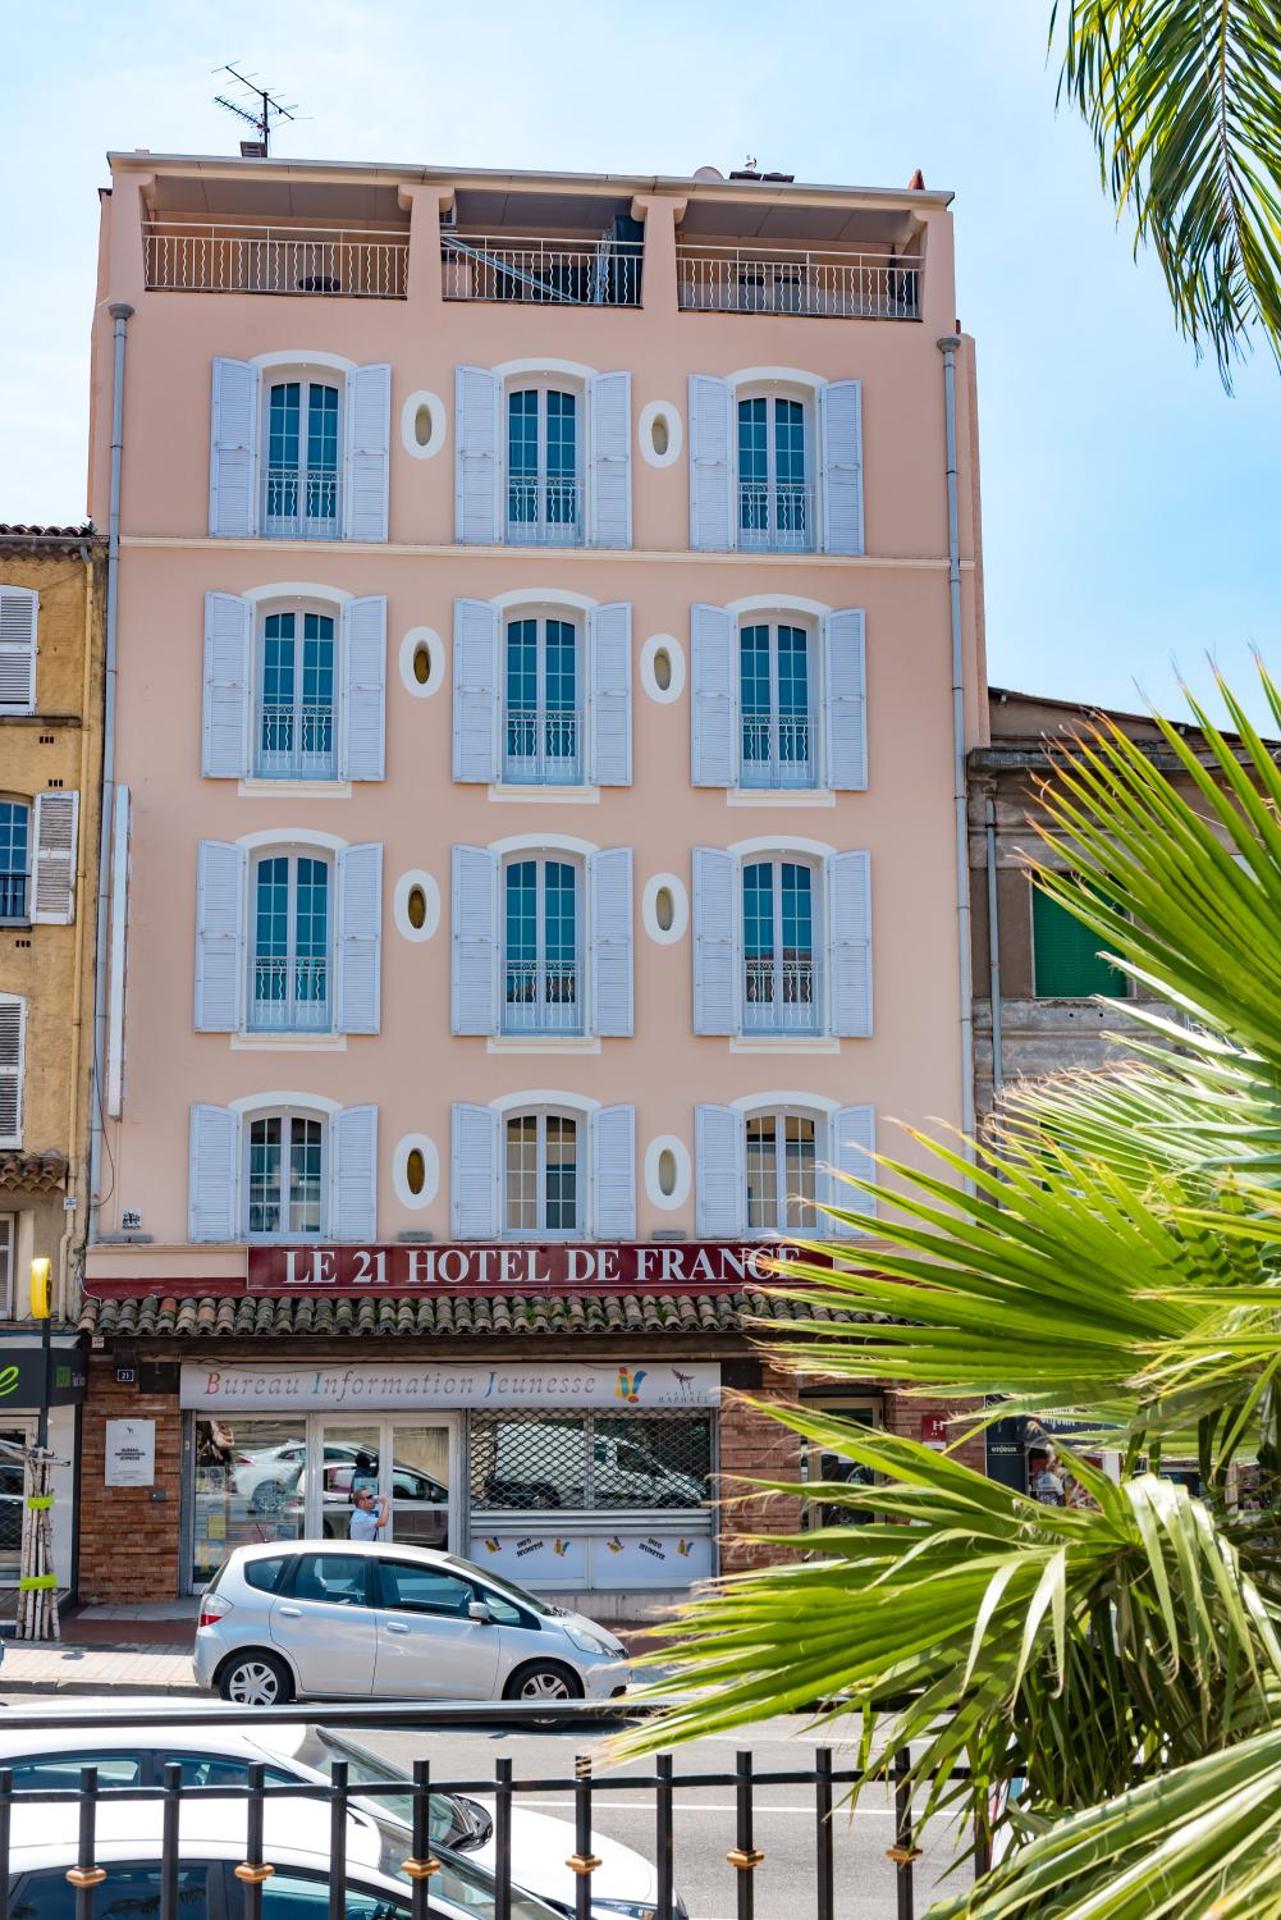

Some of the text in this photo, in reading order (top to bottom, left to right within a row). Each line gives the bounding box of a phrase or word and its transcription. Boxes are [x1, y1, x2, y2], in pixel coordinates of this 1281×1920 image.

[283, 1247, 800, 1284] LE 21 HOTEL DE FRANCE
[204, 1370, 596, 1402] Bureau Information Jeunesse
[932, 1420, 944, 1431] H
